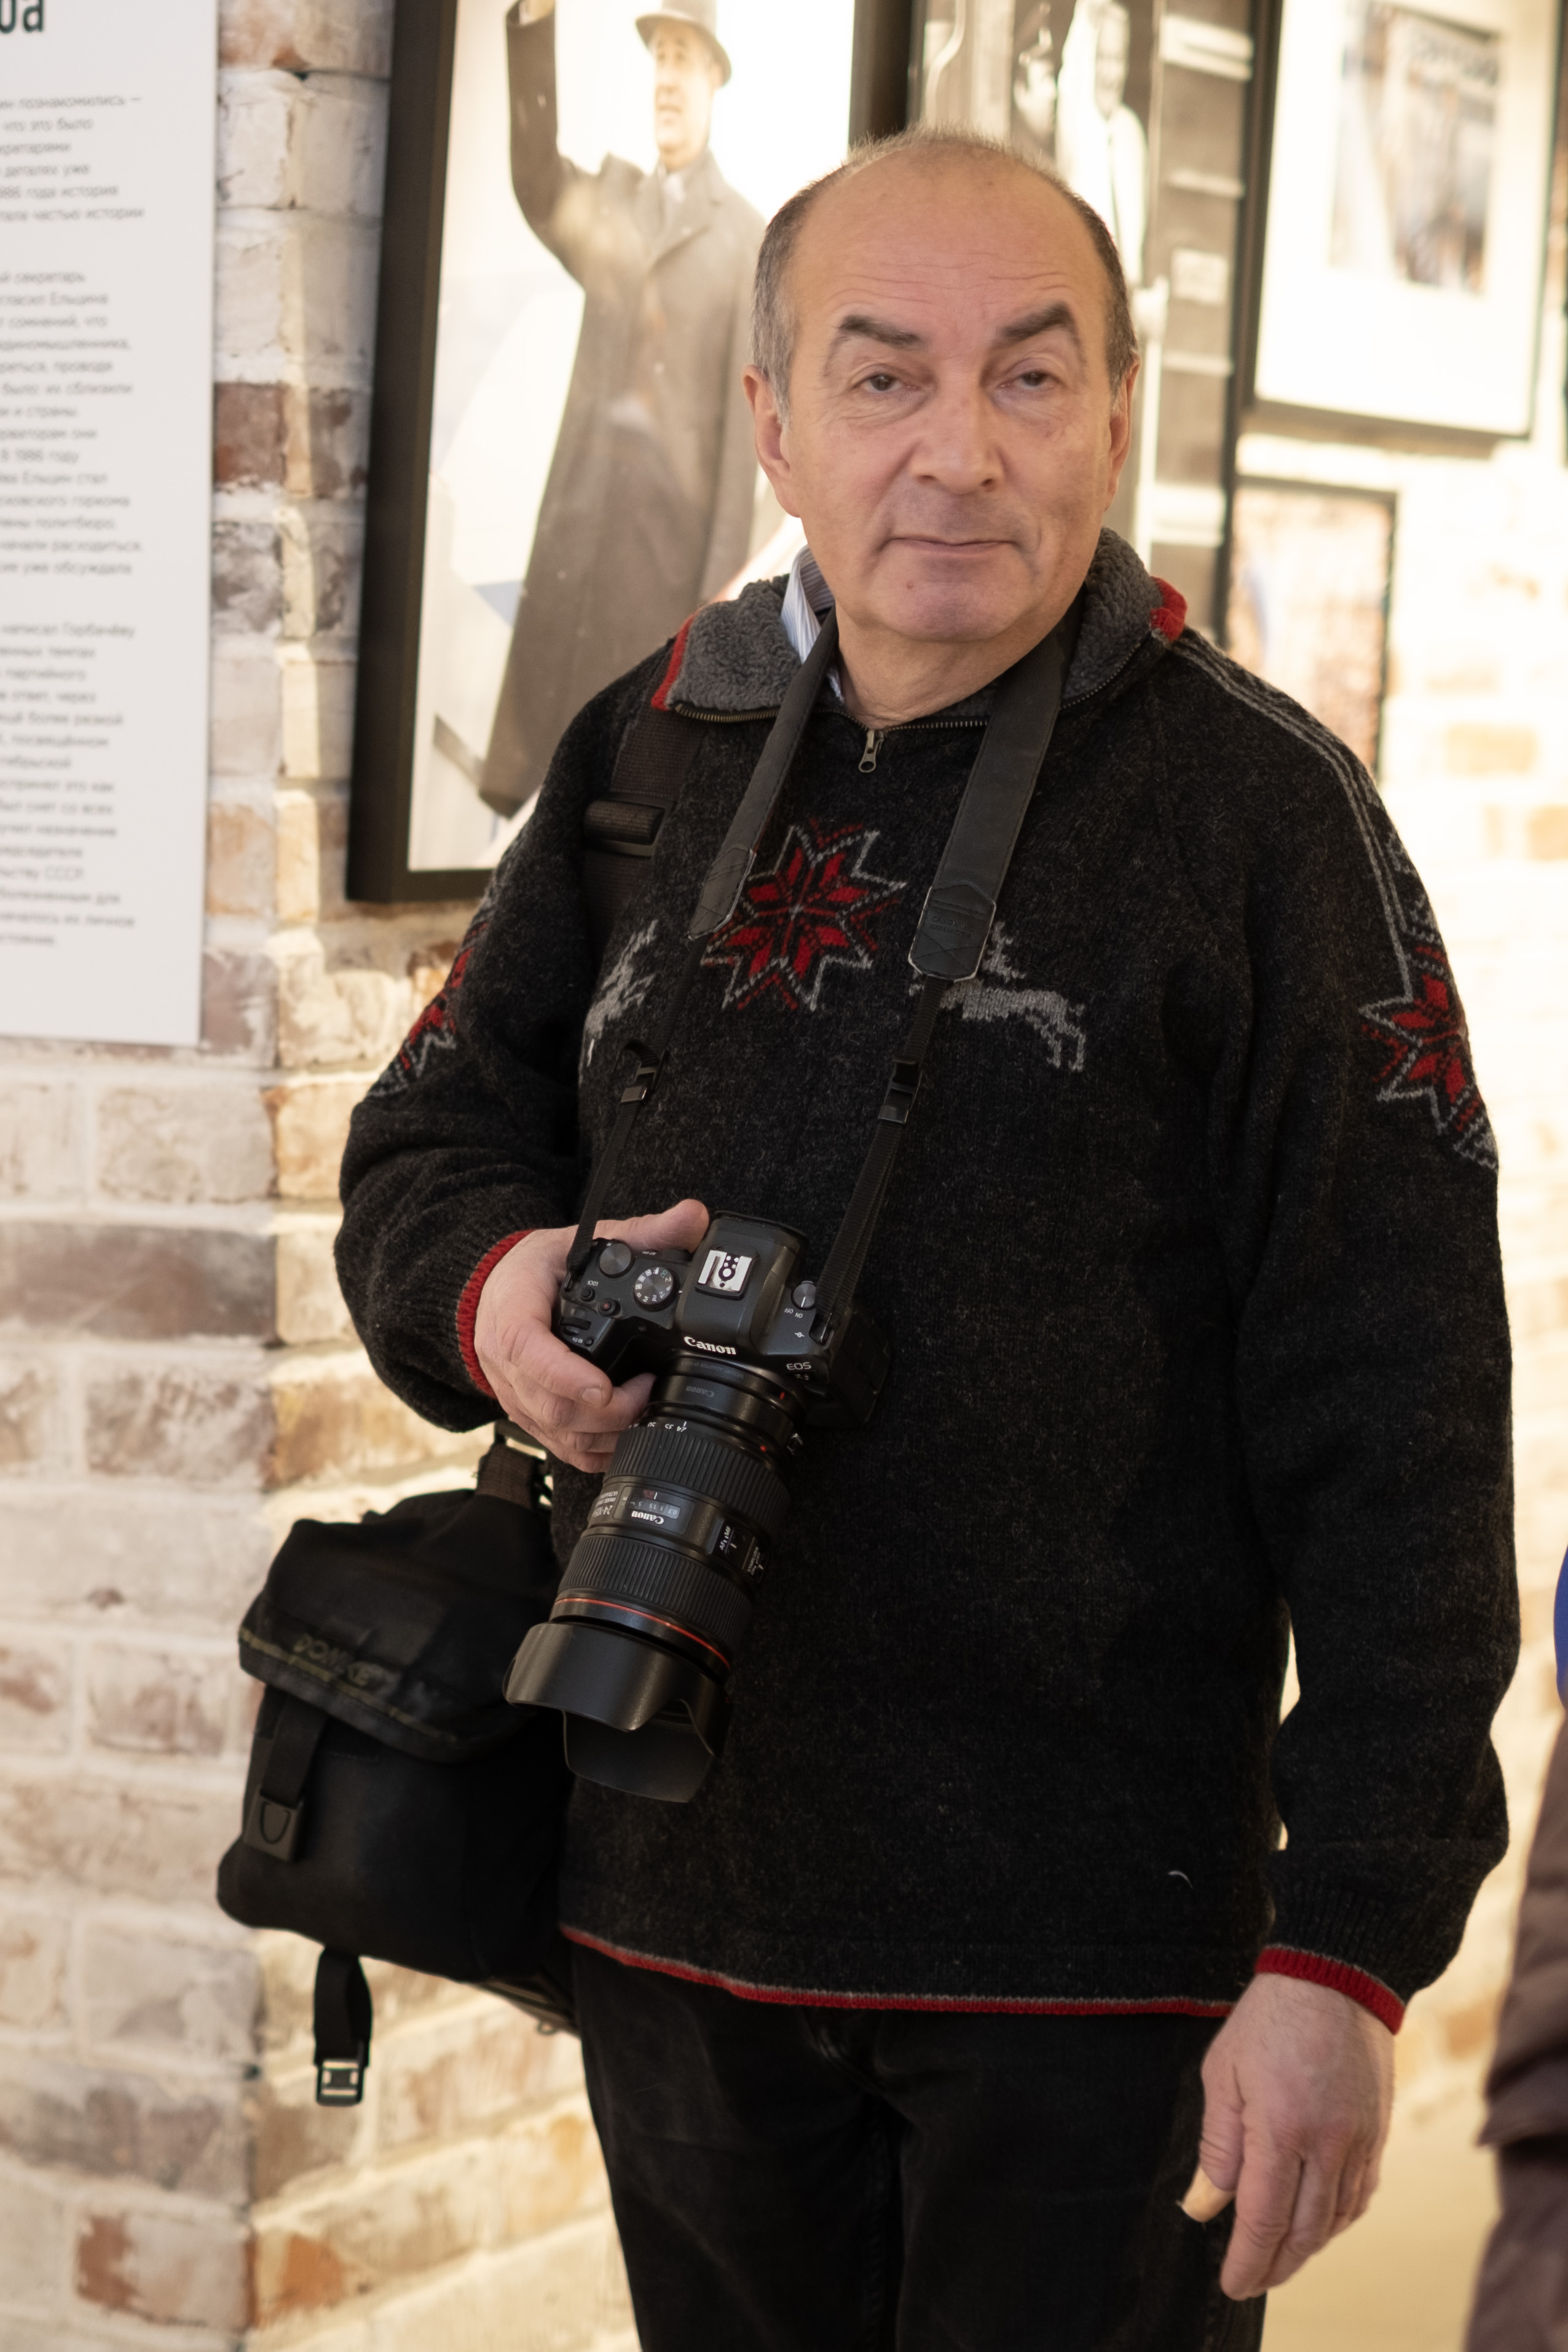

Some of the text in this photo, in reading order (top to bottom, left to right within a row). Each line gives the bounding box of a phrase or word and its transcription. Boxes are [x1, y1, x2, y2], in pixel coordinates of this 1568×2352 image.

[684, 1336, 736, 1355] Canon
[786, 1362, 811, 1370] EOS
[685, 1385, 715, 1398] Canon
[631, 1510, 664, 1525] Canon
